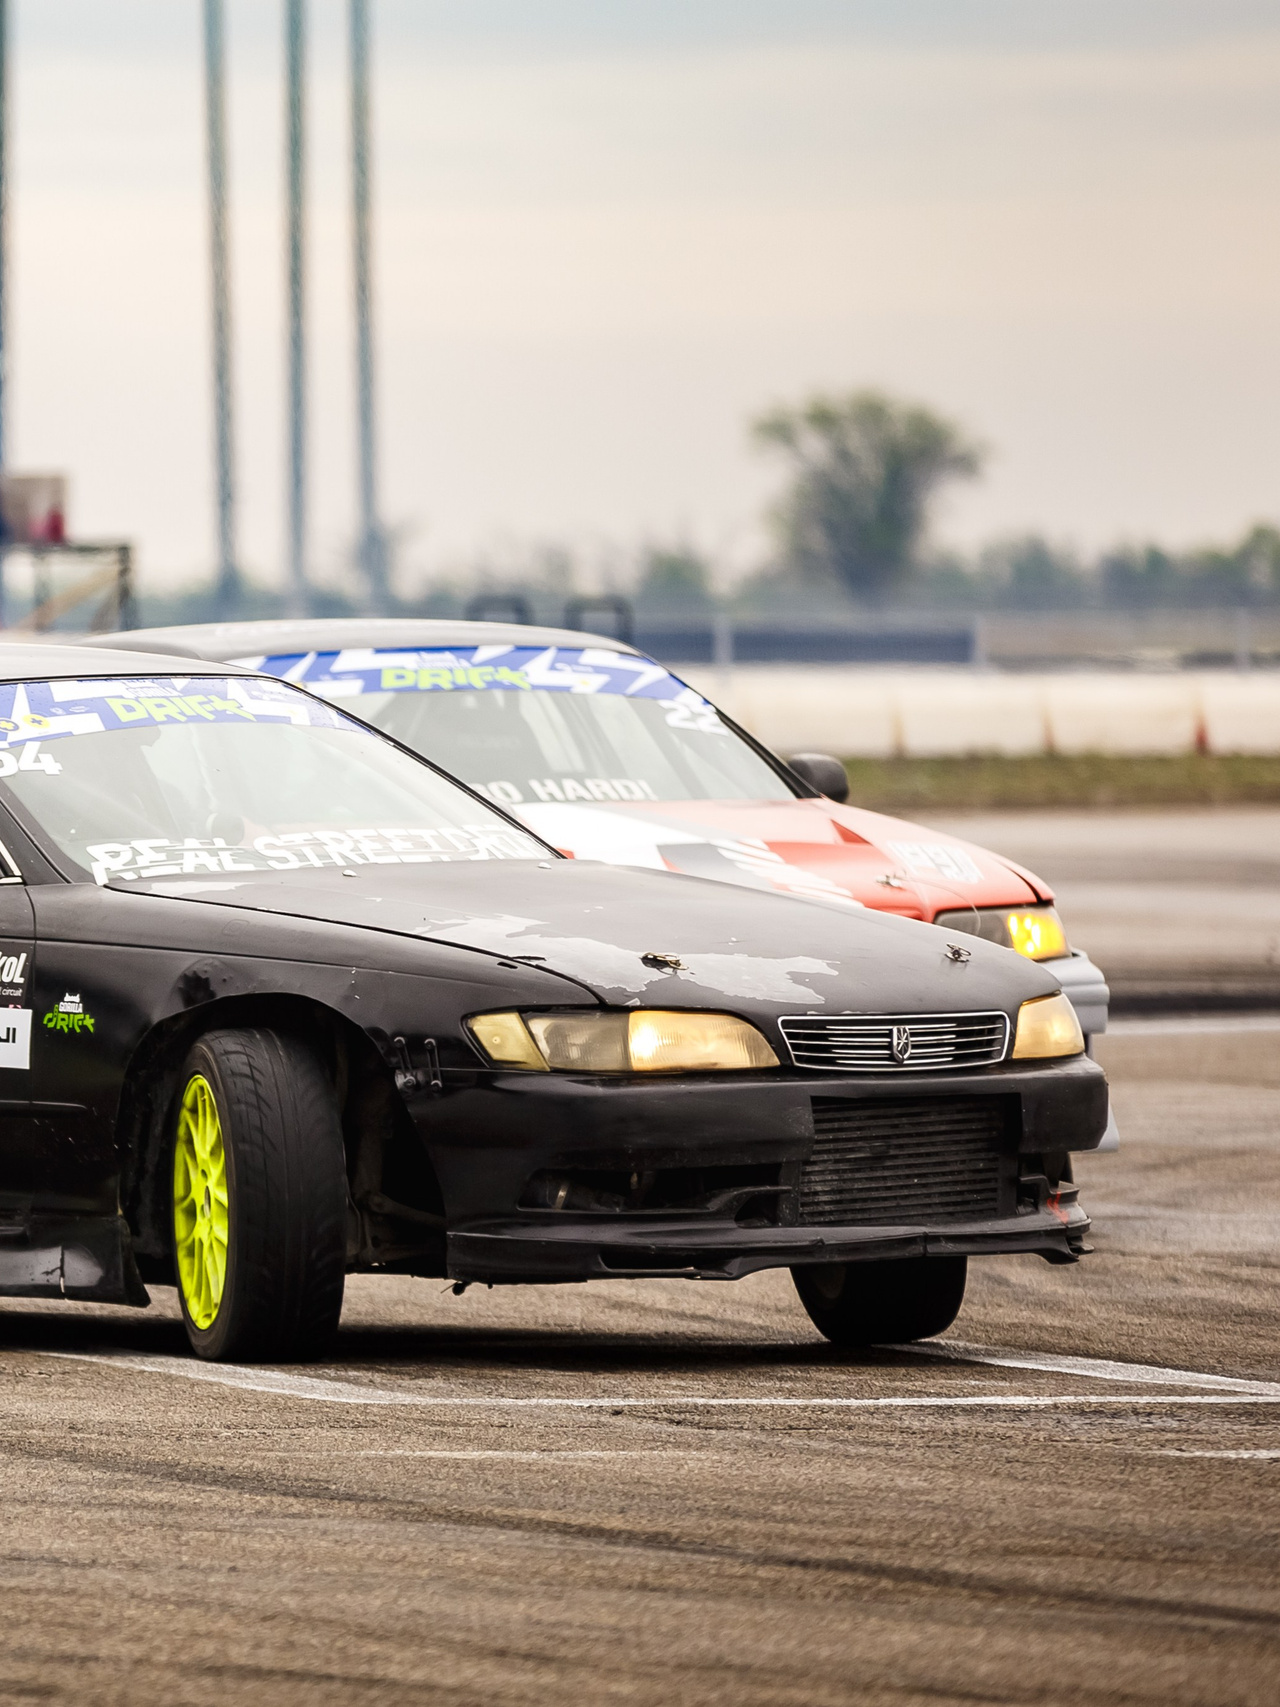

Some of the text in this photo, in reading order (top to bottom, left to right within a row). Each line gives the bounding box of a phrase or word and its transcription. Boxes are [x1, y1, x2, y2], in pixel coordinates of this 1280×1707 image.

[104, 694, 257, 723] DRIFT
[528, 778, 659, 802] HARD!
[86, 836, 254, 886] REAL
[1, 986, 23, 997] circuit
